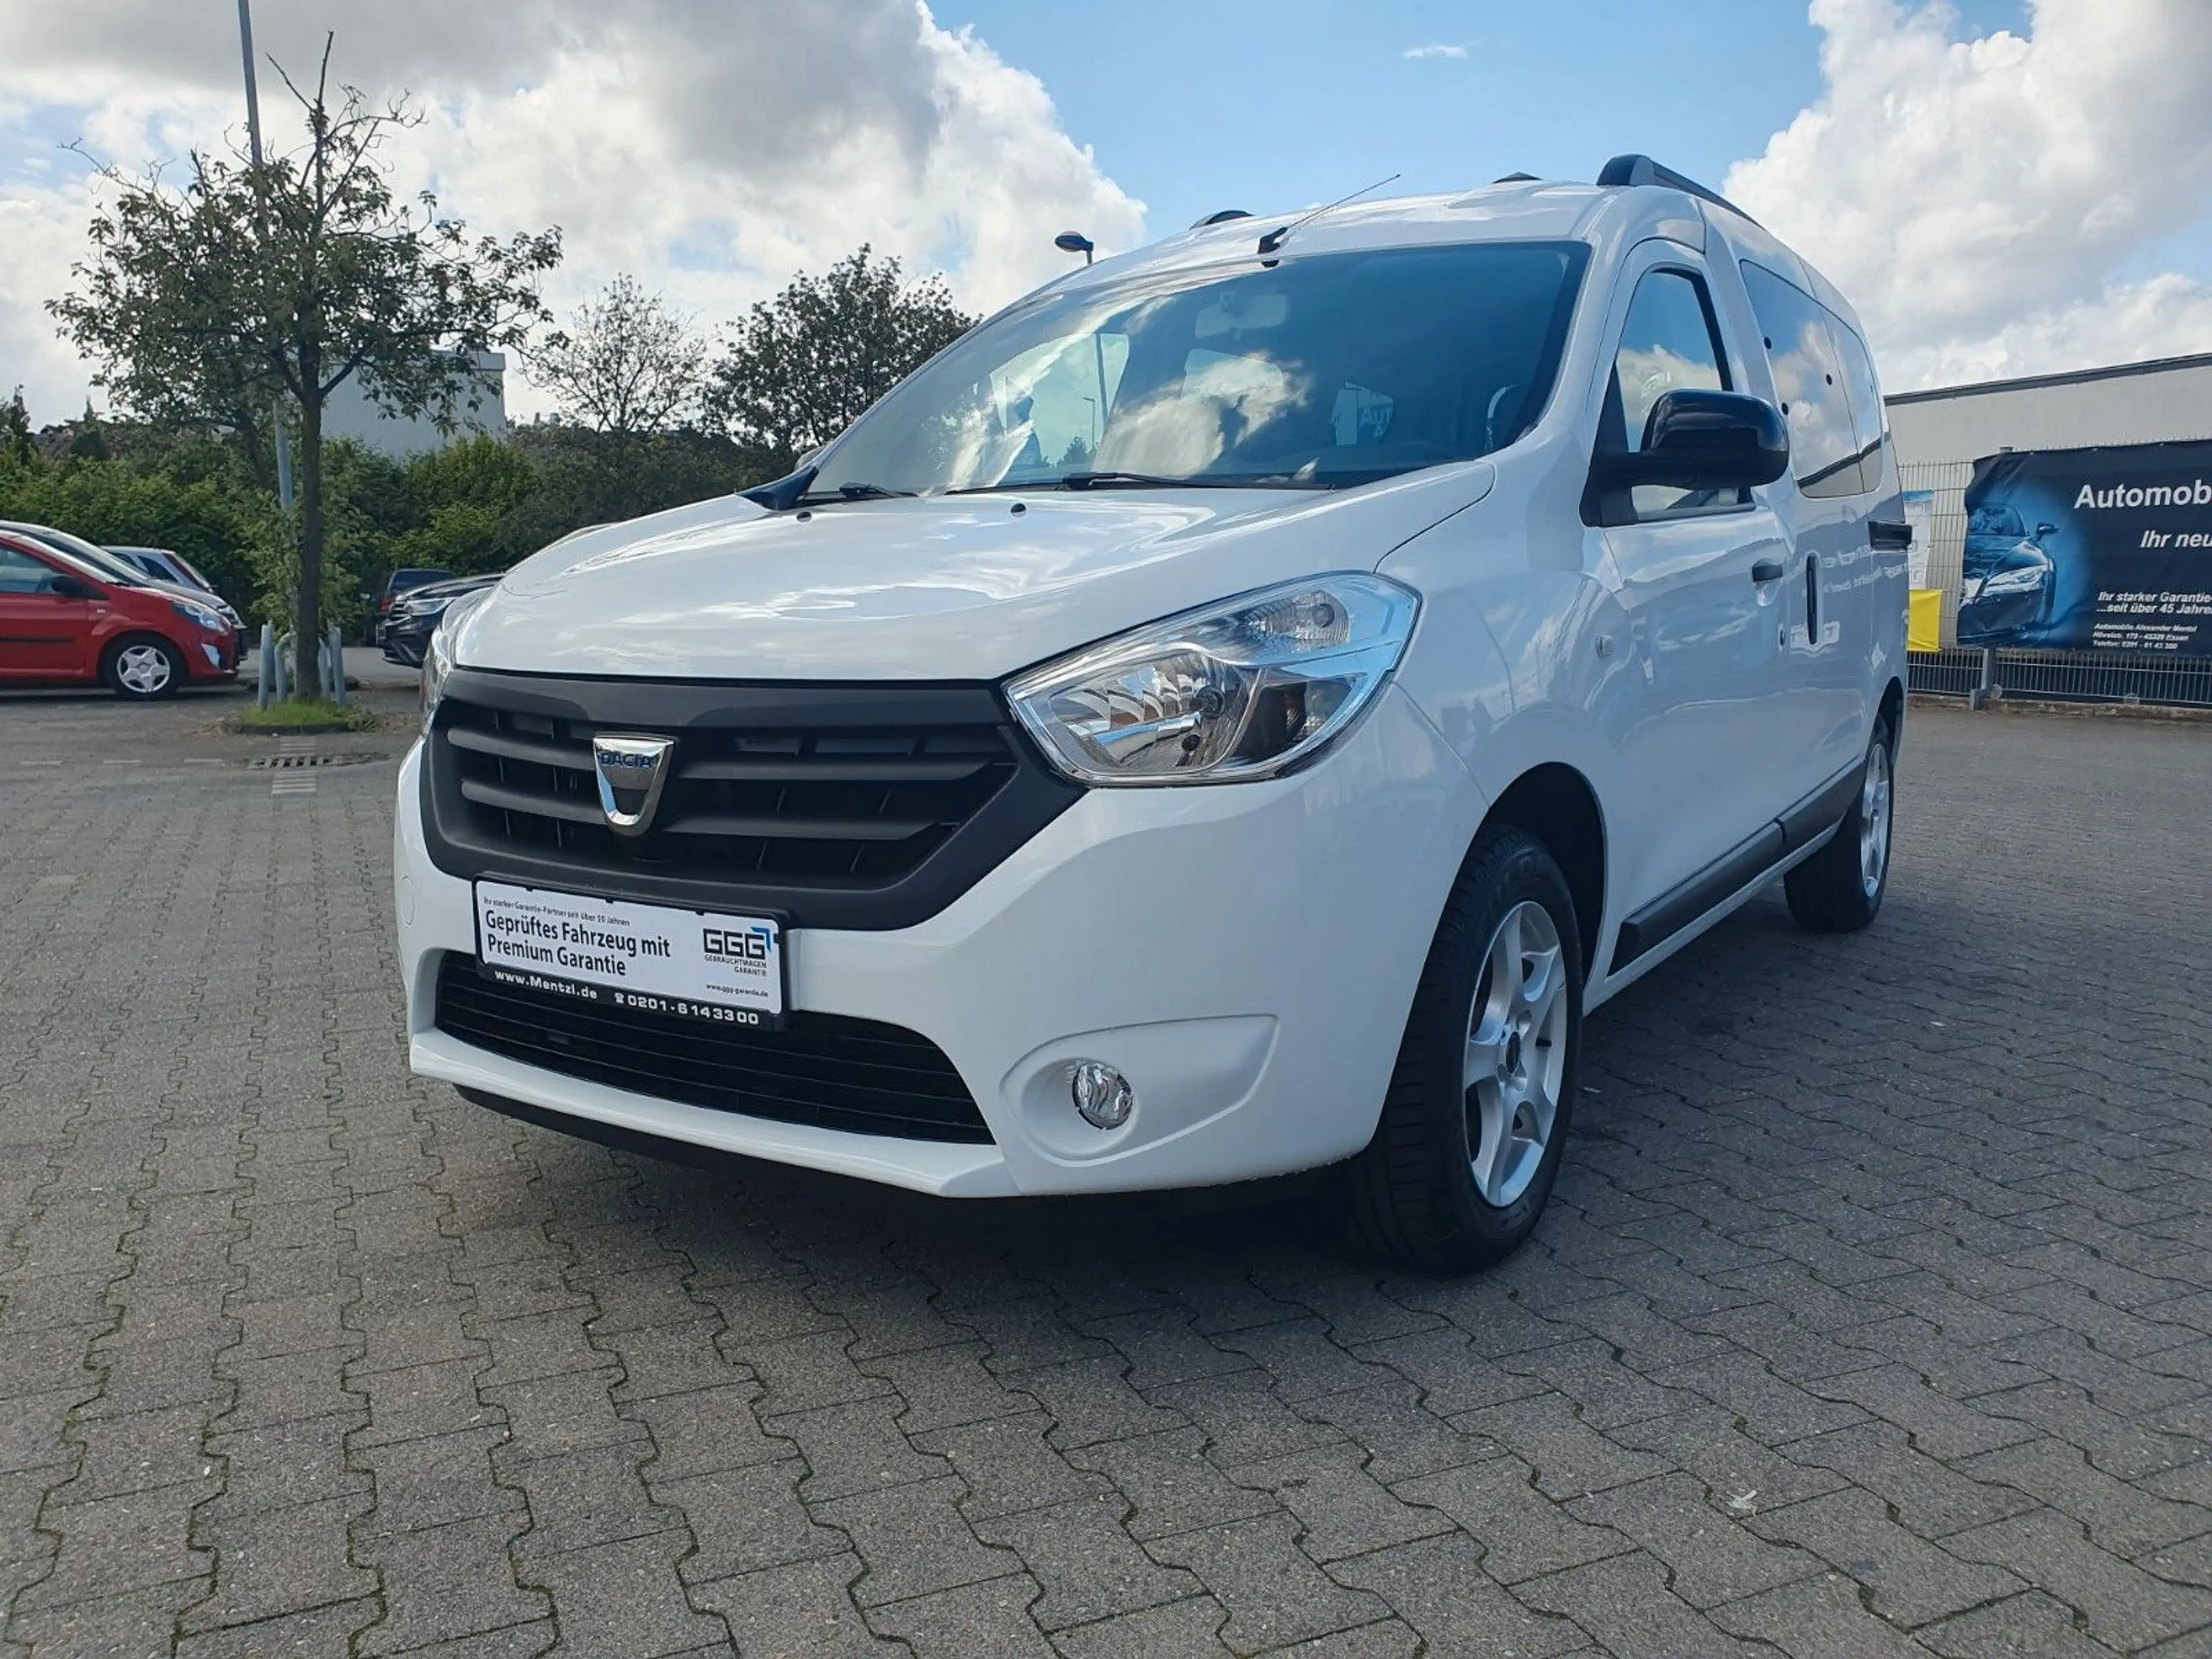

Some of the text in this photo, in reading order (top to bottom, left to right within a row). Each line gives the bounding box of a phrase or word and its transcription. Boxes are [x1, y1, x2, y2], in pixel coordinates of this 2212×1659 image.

[2074, 479, 2212, 509] Automob
[2140, 529, 2212, 548] Ihr neu
[2098, 591, 2115, 601] Ihr
[2116, 592, 2158, 602] starker
[2130, 603, 2157, 613] über
[2160, 604, 2174, 613] 45
[600, 752, 653, 769] DACIA
[485, 910, 671, 957] Geprüftes Fahrzeug mit
[703, 927, 766, 960] GGG
[488, 933, 626, 976] Premium Garantie
[704, 955, 767, 969] GEBRAUCHTWAGEN
[733, 966, 767, 977] GARANTIE
[494, 969, 597, 999] www.Mentzl.de
